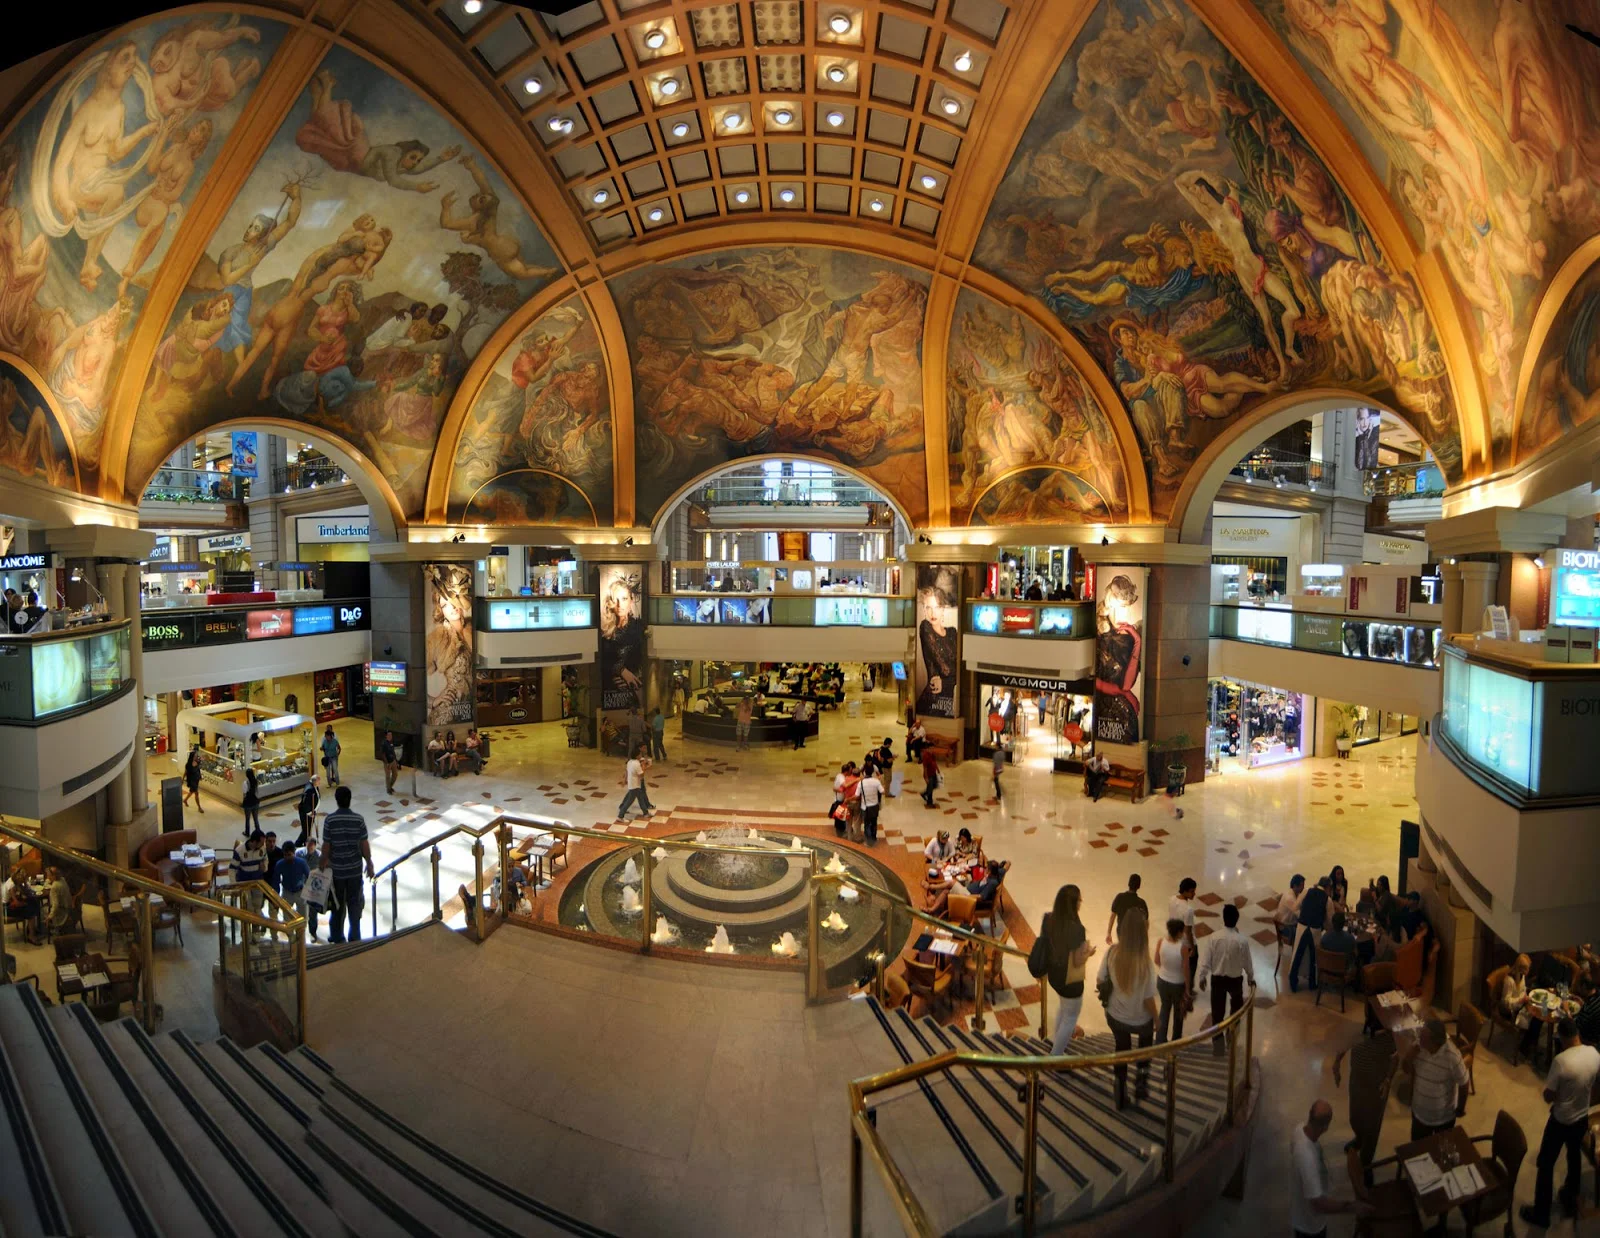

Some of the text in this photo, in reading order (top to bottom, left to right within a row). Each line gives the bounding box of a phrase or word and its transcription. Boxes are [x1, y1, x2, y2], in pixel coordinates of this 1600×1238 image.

[318, 525, 370, 536] Timberland
[0, 555, 45, 569] LANCÔME
[341, 607, 361, 621] D&G
[566, 609, 585, 617] VICHY
[149, 625, 179, 637] BOSS
[206, 623, 237, 631] BREIL
[1002, 676, 1067, 691] YAGMOUR
